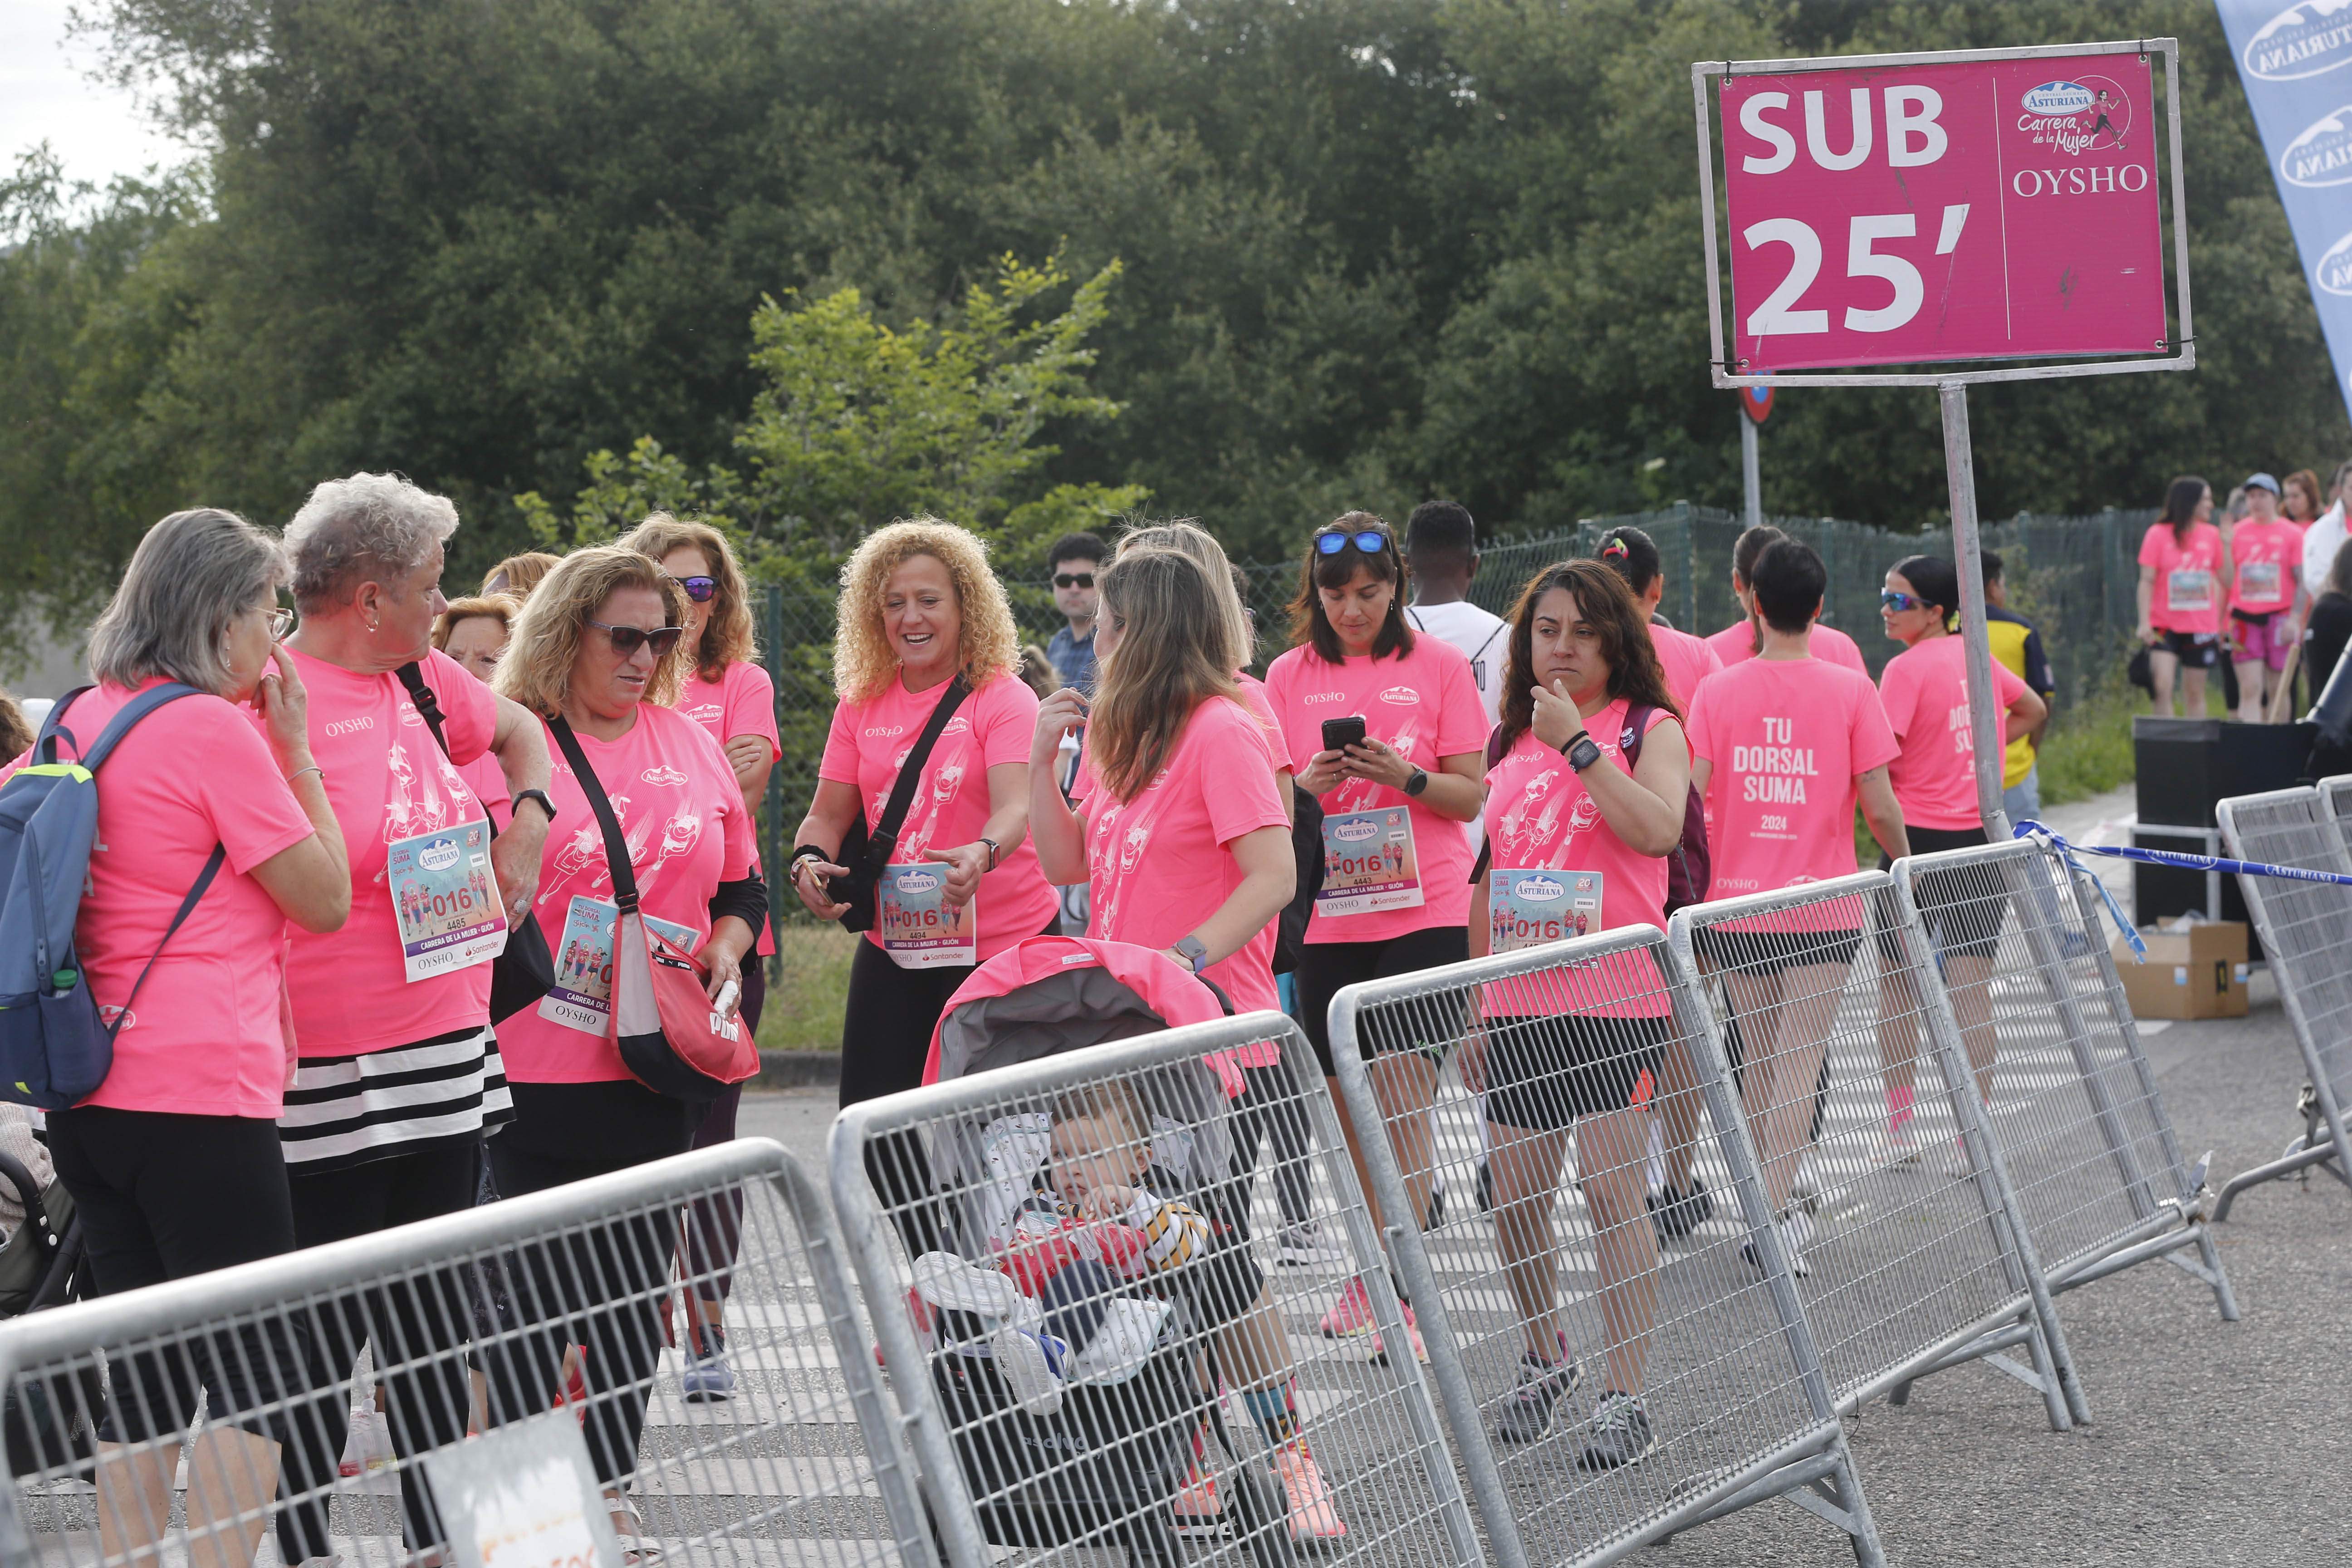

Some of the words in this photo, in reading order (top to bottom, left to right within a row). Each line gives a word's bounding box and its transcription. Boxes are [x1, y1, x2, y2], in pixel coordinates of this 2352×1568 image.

[2028, 94, 2088, 108] ASTURIANA
[1739, 85, 1948, 175] SUB
[2017, 114, 2077, 131] Carrera
[2033, 132, 2044, 144] de
[2046, 130, 2054, 143] la
[2053, 126, 2099, 156] Mujer
[2013, 164, 2148, 197] OYSHO
[1304, 691, 1345, 705] OYSHO
[1382, 693, 1417, 701] ASTURIANA
[326, 716, 374, 737] OYSHO
[865, 725, 903, 737] OYSHO
[1763, 717, 1792, 745] TU
[1504, 751, 1544, 767] OYSHO
[1733, 745, 1819, 775] DORSAL
[1743, 775, 1806, 804] SUMA
[1761, 814, 1788, 830] 2024
[1338, 828, 1376, 838] ASTURIANA
[393, 853, 411, 865] SUMA
[422, 850, 459, 867] ASTURIANA
[1342, 855, 1382, 875] 016
[1354, 877, 1372, 885] 4443
[2271, 865, 2332, 883] ASTURIANA
[899, 880, 935, 889] ASTURIANA
[1518, 885, 1561, 896] ASTURIANA
[1716, 878, 1759, 891] OYSHO
[1328, 889, 1351, 897] CARRERA
[432, 887, 472, 916] 016
[1327, 900, 1359, 911] OYSHO
[1378, 895, 1411, 904] Santander
[577, 909, 600, 922] SUMA
[902, 909, 938, 927] 016
[447, 917, 466, 931] 4485
[1516, 919, 1560, 939] 016
[421, 938, 446, 950] CARRERA
[462, 928, 478, 939] MUJER
[481, 921, 495, 933] GIJÓN
[910, 931, 926, 939] 4494
[418, 952, 453, 970] OYSHO
[472, 940, 499, 955] Santander
[567, 993, 595, 1007] CARRERA
[596, 1001, 605, 1009] DE
[555, 1005, 597, 1025] OYSHO
